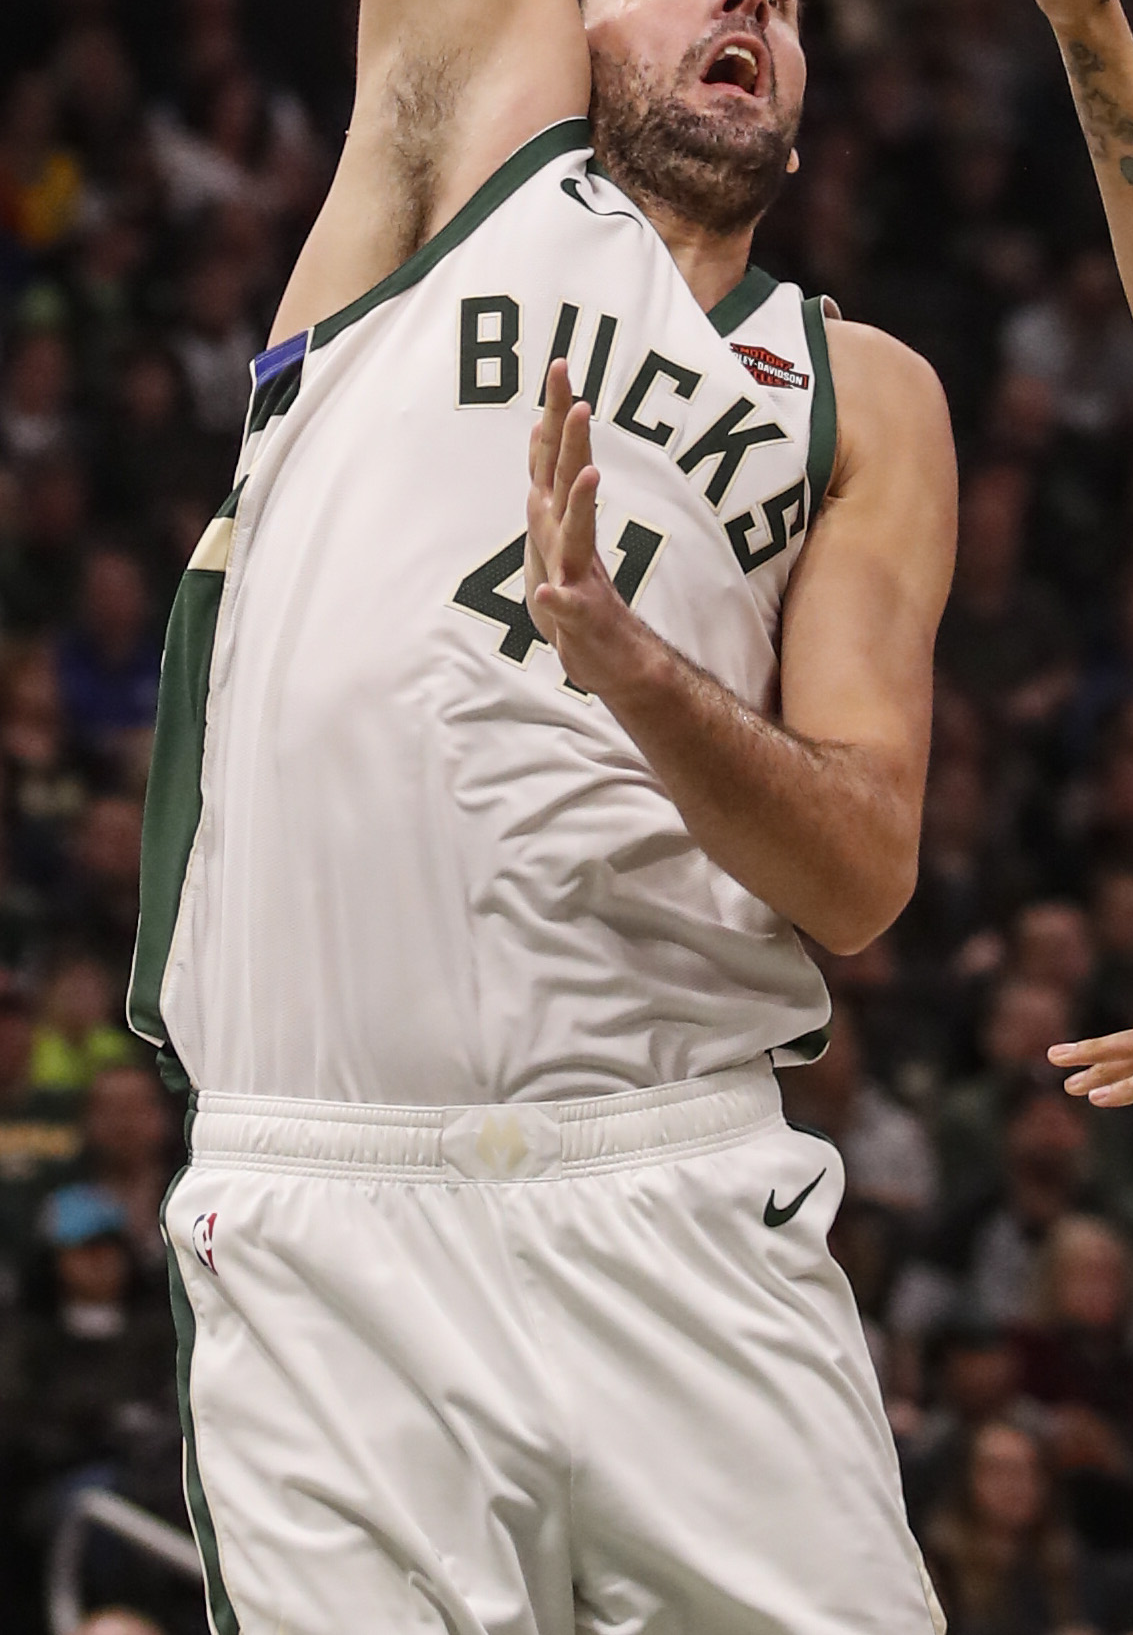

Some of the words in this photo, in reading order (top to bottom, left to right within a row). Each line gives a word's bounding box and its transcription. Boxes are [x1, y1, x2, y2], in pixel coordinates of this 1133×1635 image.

[456, 294, 807, 575] BUCKS
[735, 354, 803, 386] LEY-DAVIDSON
[445, 500, 671, 705] 41
